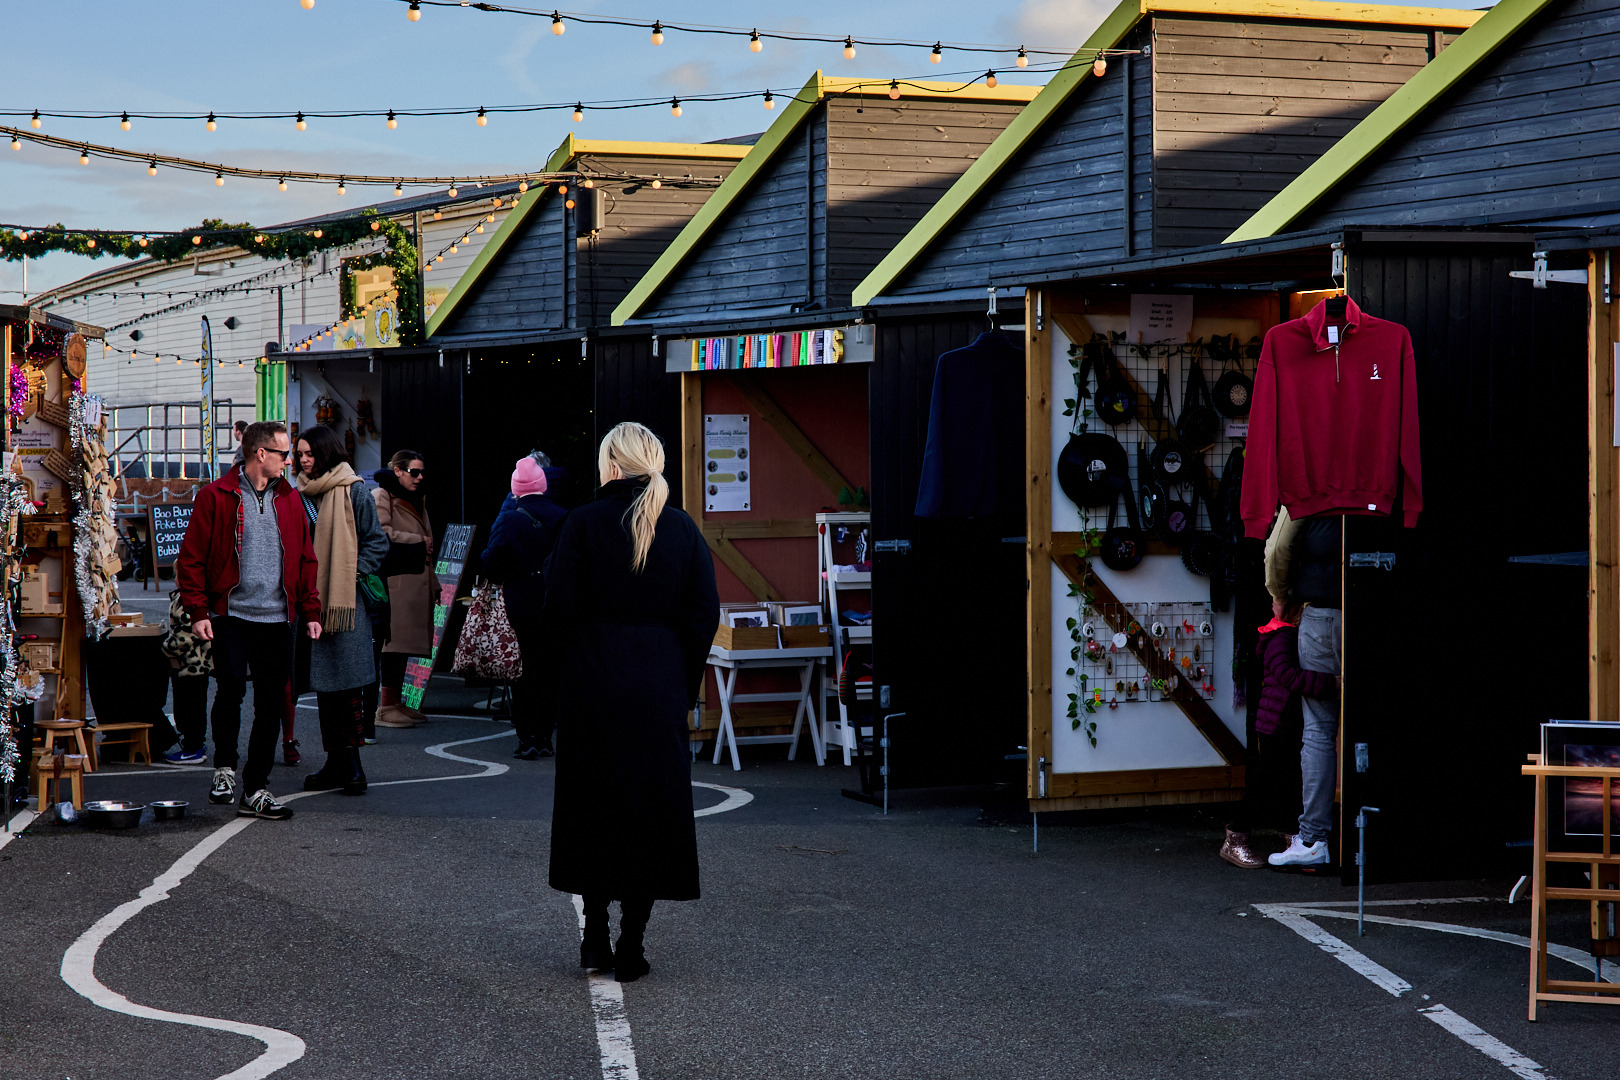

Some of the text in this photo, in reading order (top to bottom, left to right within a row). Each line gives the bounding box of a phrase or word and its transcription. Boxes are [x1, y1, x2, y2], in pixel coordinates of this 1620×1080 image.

[691, 329, 844, 372] LEMON FAMILY MAKERS
[155, 519, 177, 530] Poke
[157, 544, 181, 557] Bubbl
